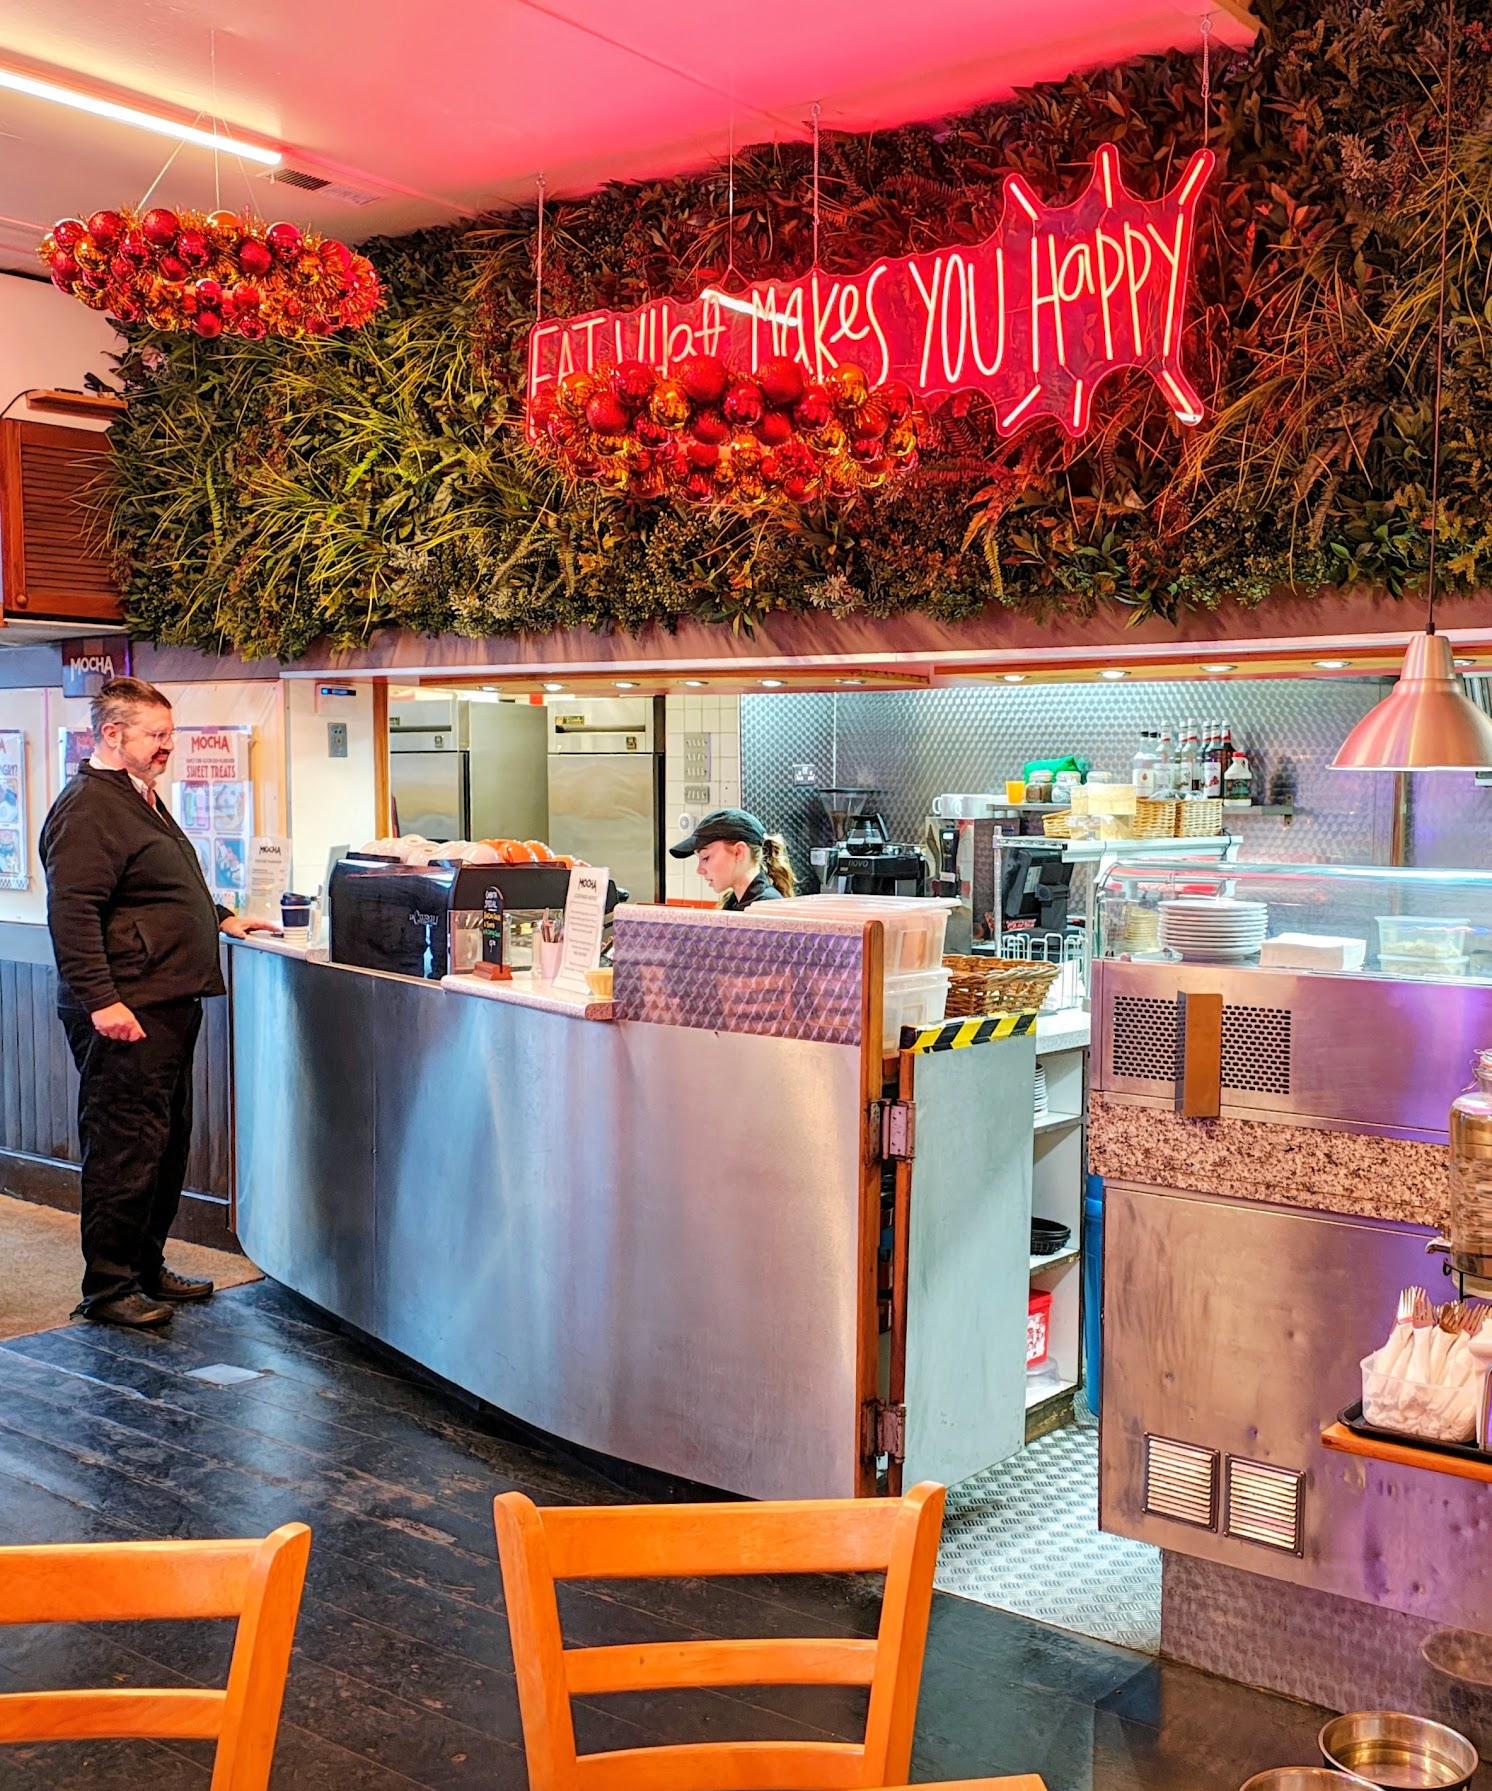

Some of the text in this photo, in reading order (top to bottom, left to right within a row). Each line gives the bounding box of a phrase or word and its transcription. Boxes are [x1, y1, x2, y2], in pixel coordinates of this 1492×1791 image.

[908, 248, 1004, 388] YOU
[70, 655, 115, 682] MOCHA
[191, 735, 230, 754] MOCHA
[186, 765, 236, 779] SWEET TREATS
[259, 845, 281, 856] MOCHA
[577, 877, 597, 893] MOCHA
